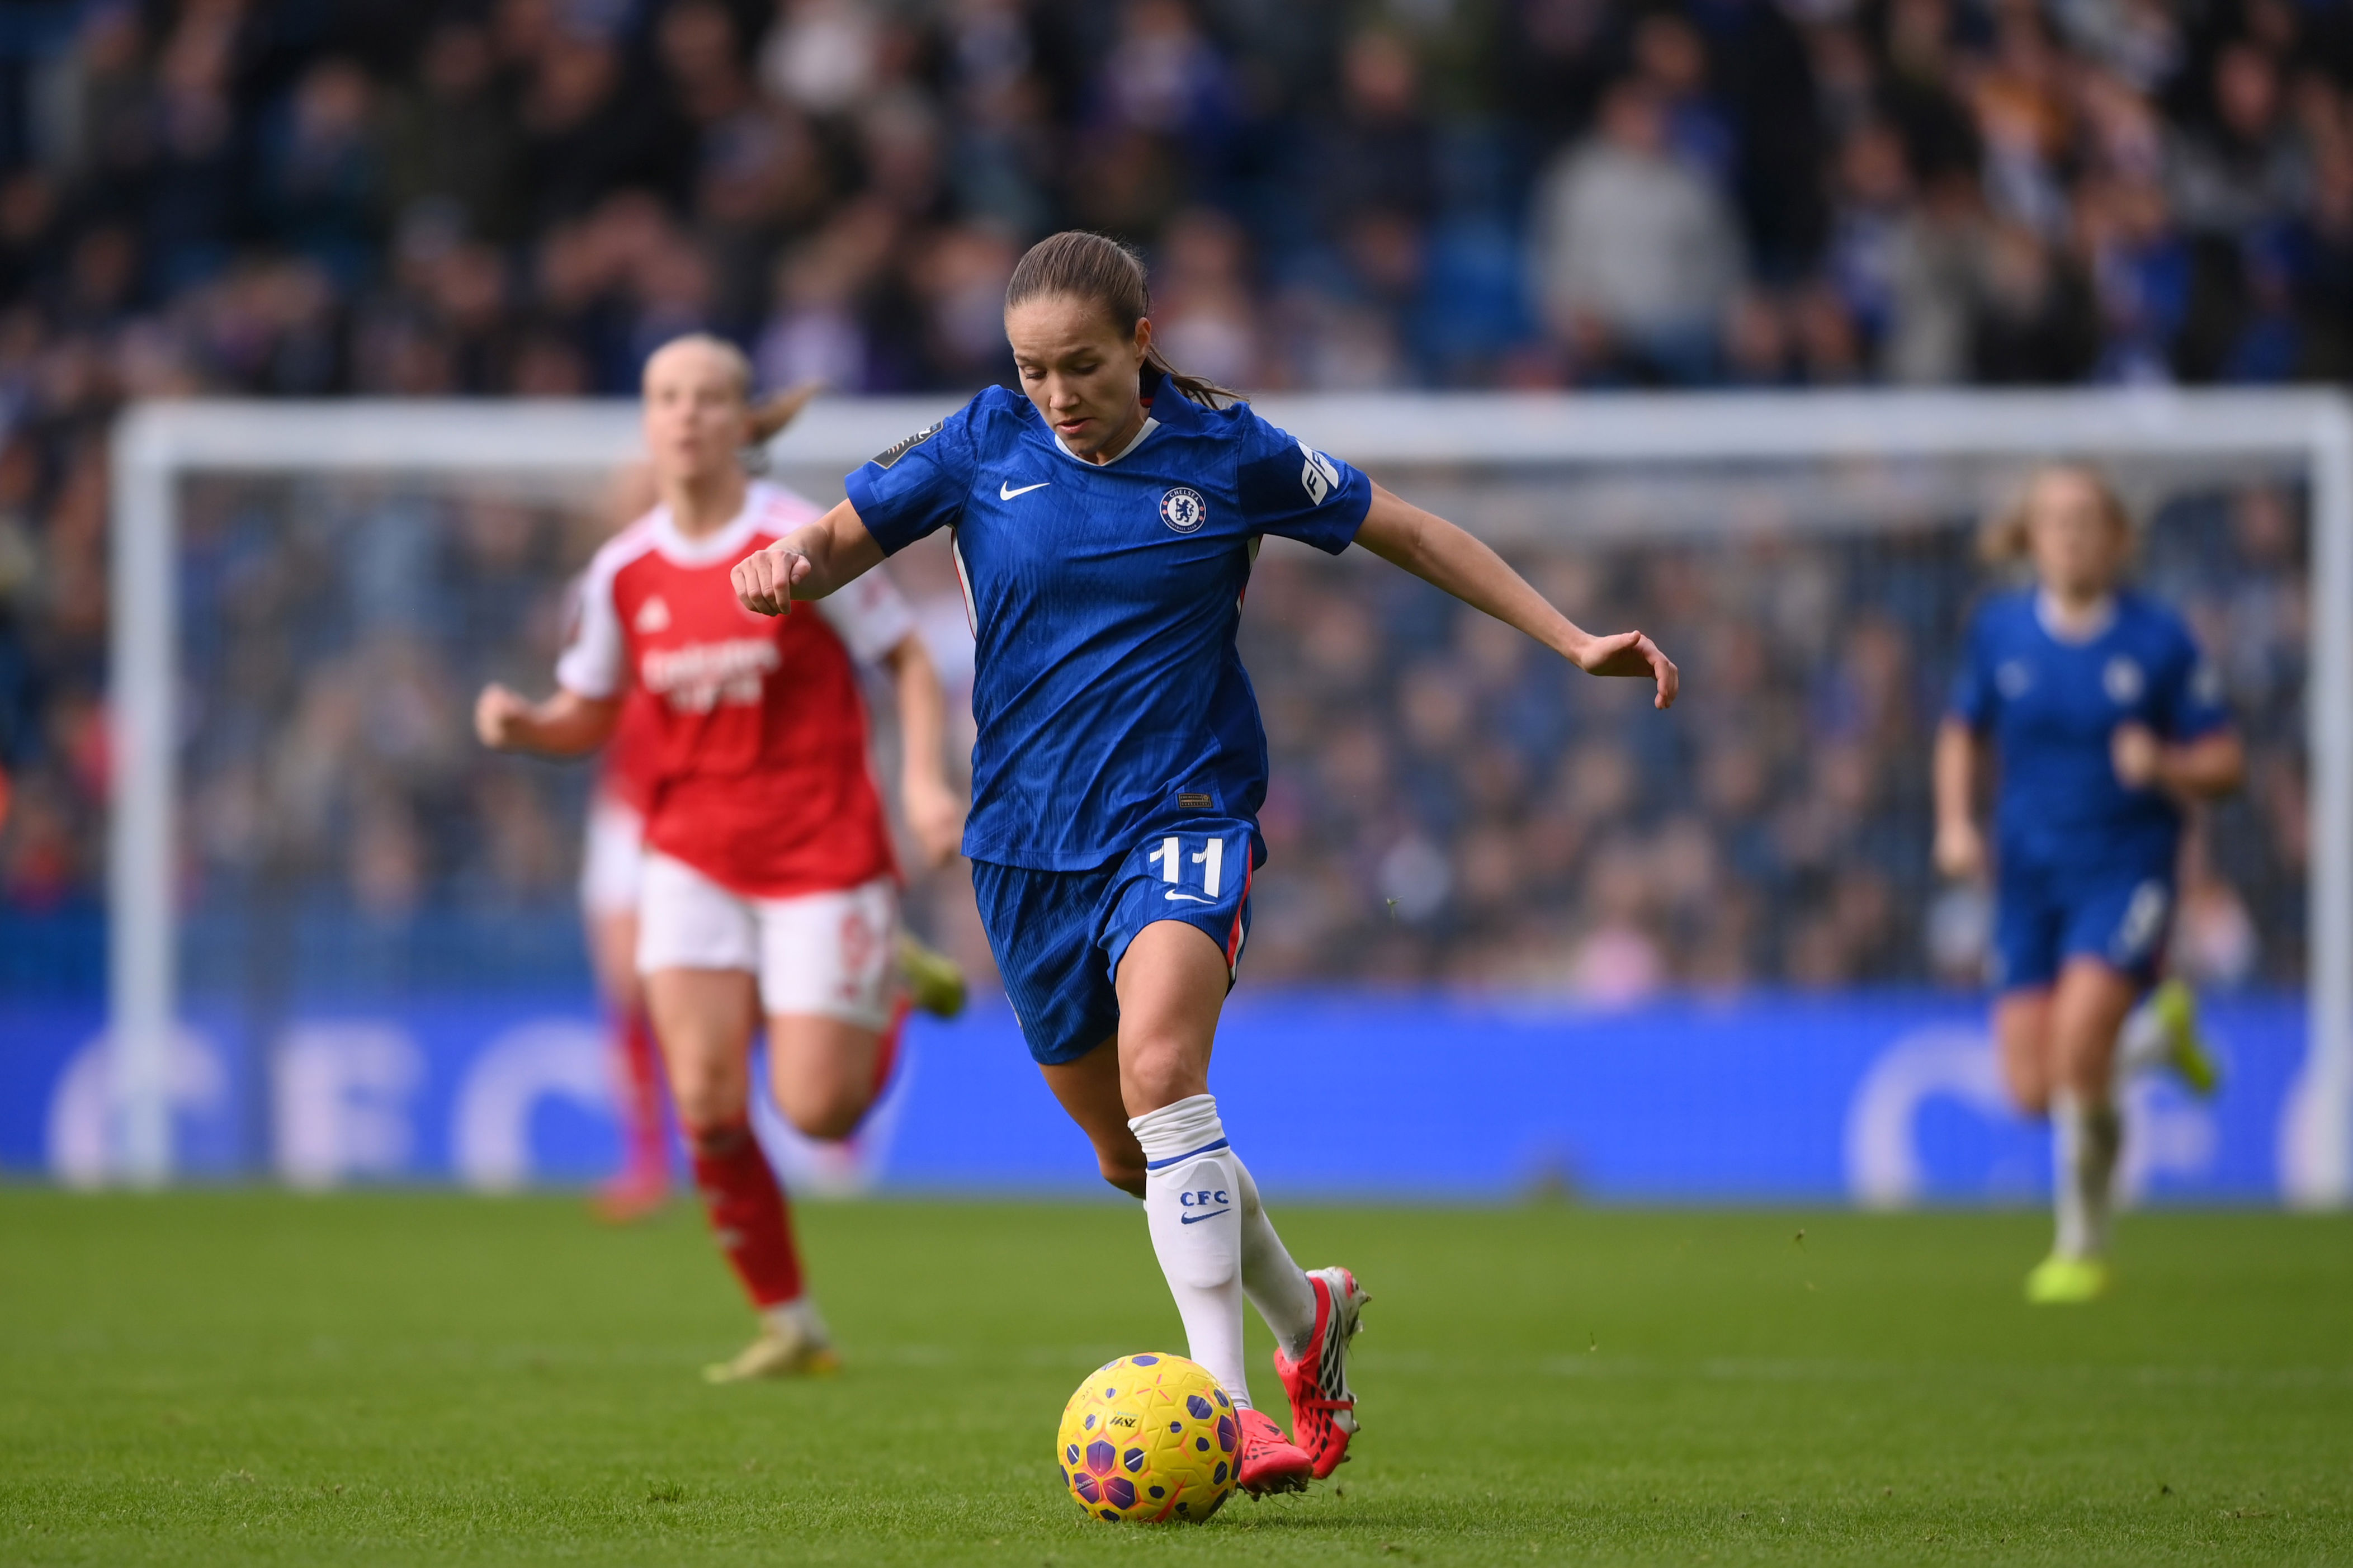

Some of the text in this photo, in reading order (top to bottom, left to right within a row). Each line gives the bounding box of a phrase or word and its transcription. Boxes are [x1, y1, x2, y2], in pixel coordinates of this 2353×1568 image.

[1169, 489, 1199, 502] CHELSEA
[1149, 837, 1223, 899] 11
[1180, 1191, 1229, 1207] CFC
